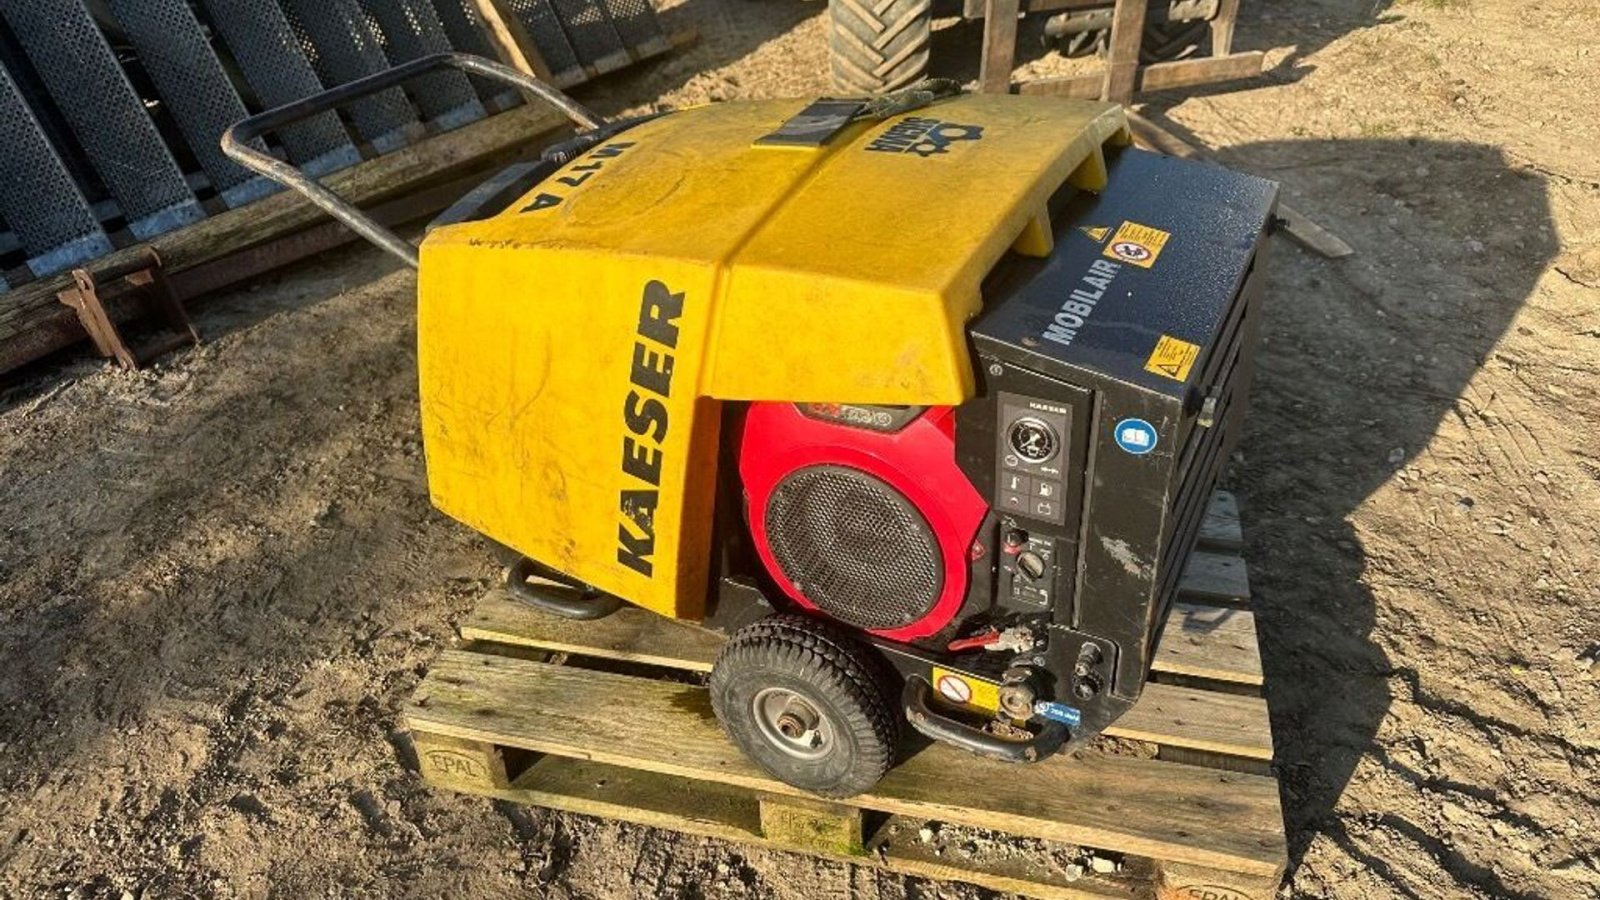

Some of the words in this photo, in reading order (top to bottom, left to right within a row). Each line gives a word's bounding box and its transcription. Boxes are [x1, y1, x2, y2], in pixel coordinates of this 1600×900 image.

[556, 142, 637, 187] M17
[518, 192, 564, 213] A
[1042, 259, 1122, 346] MOBILAIR
[617, 279, 685, 579] KAESER
[429, 754, 479, 778] EPAL
